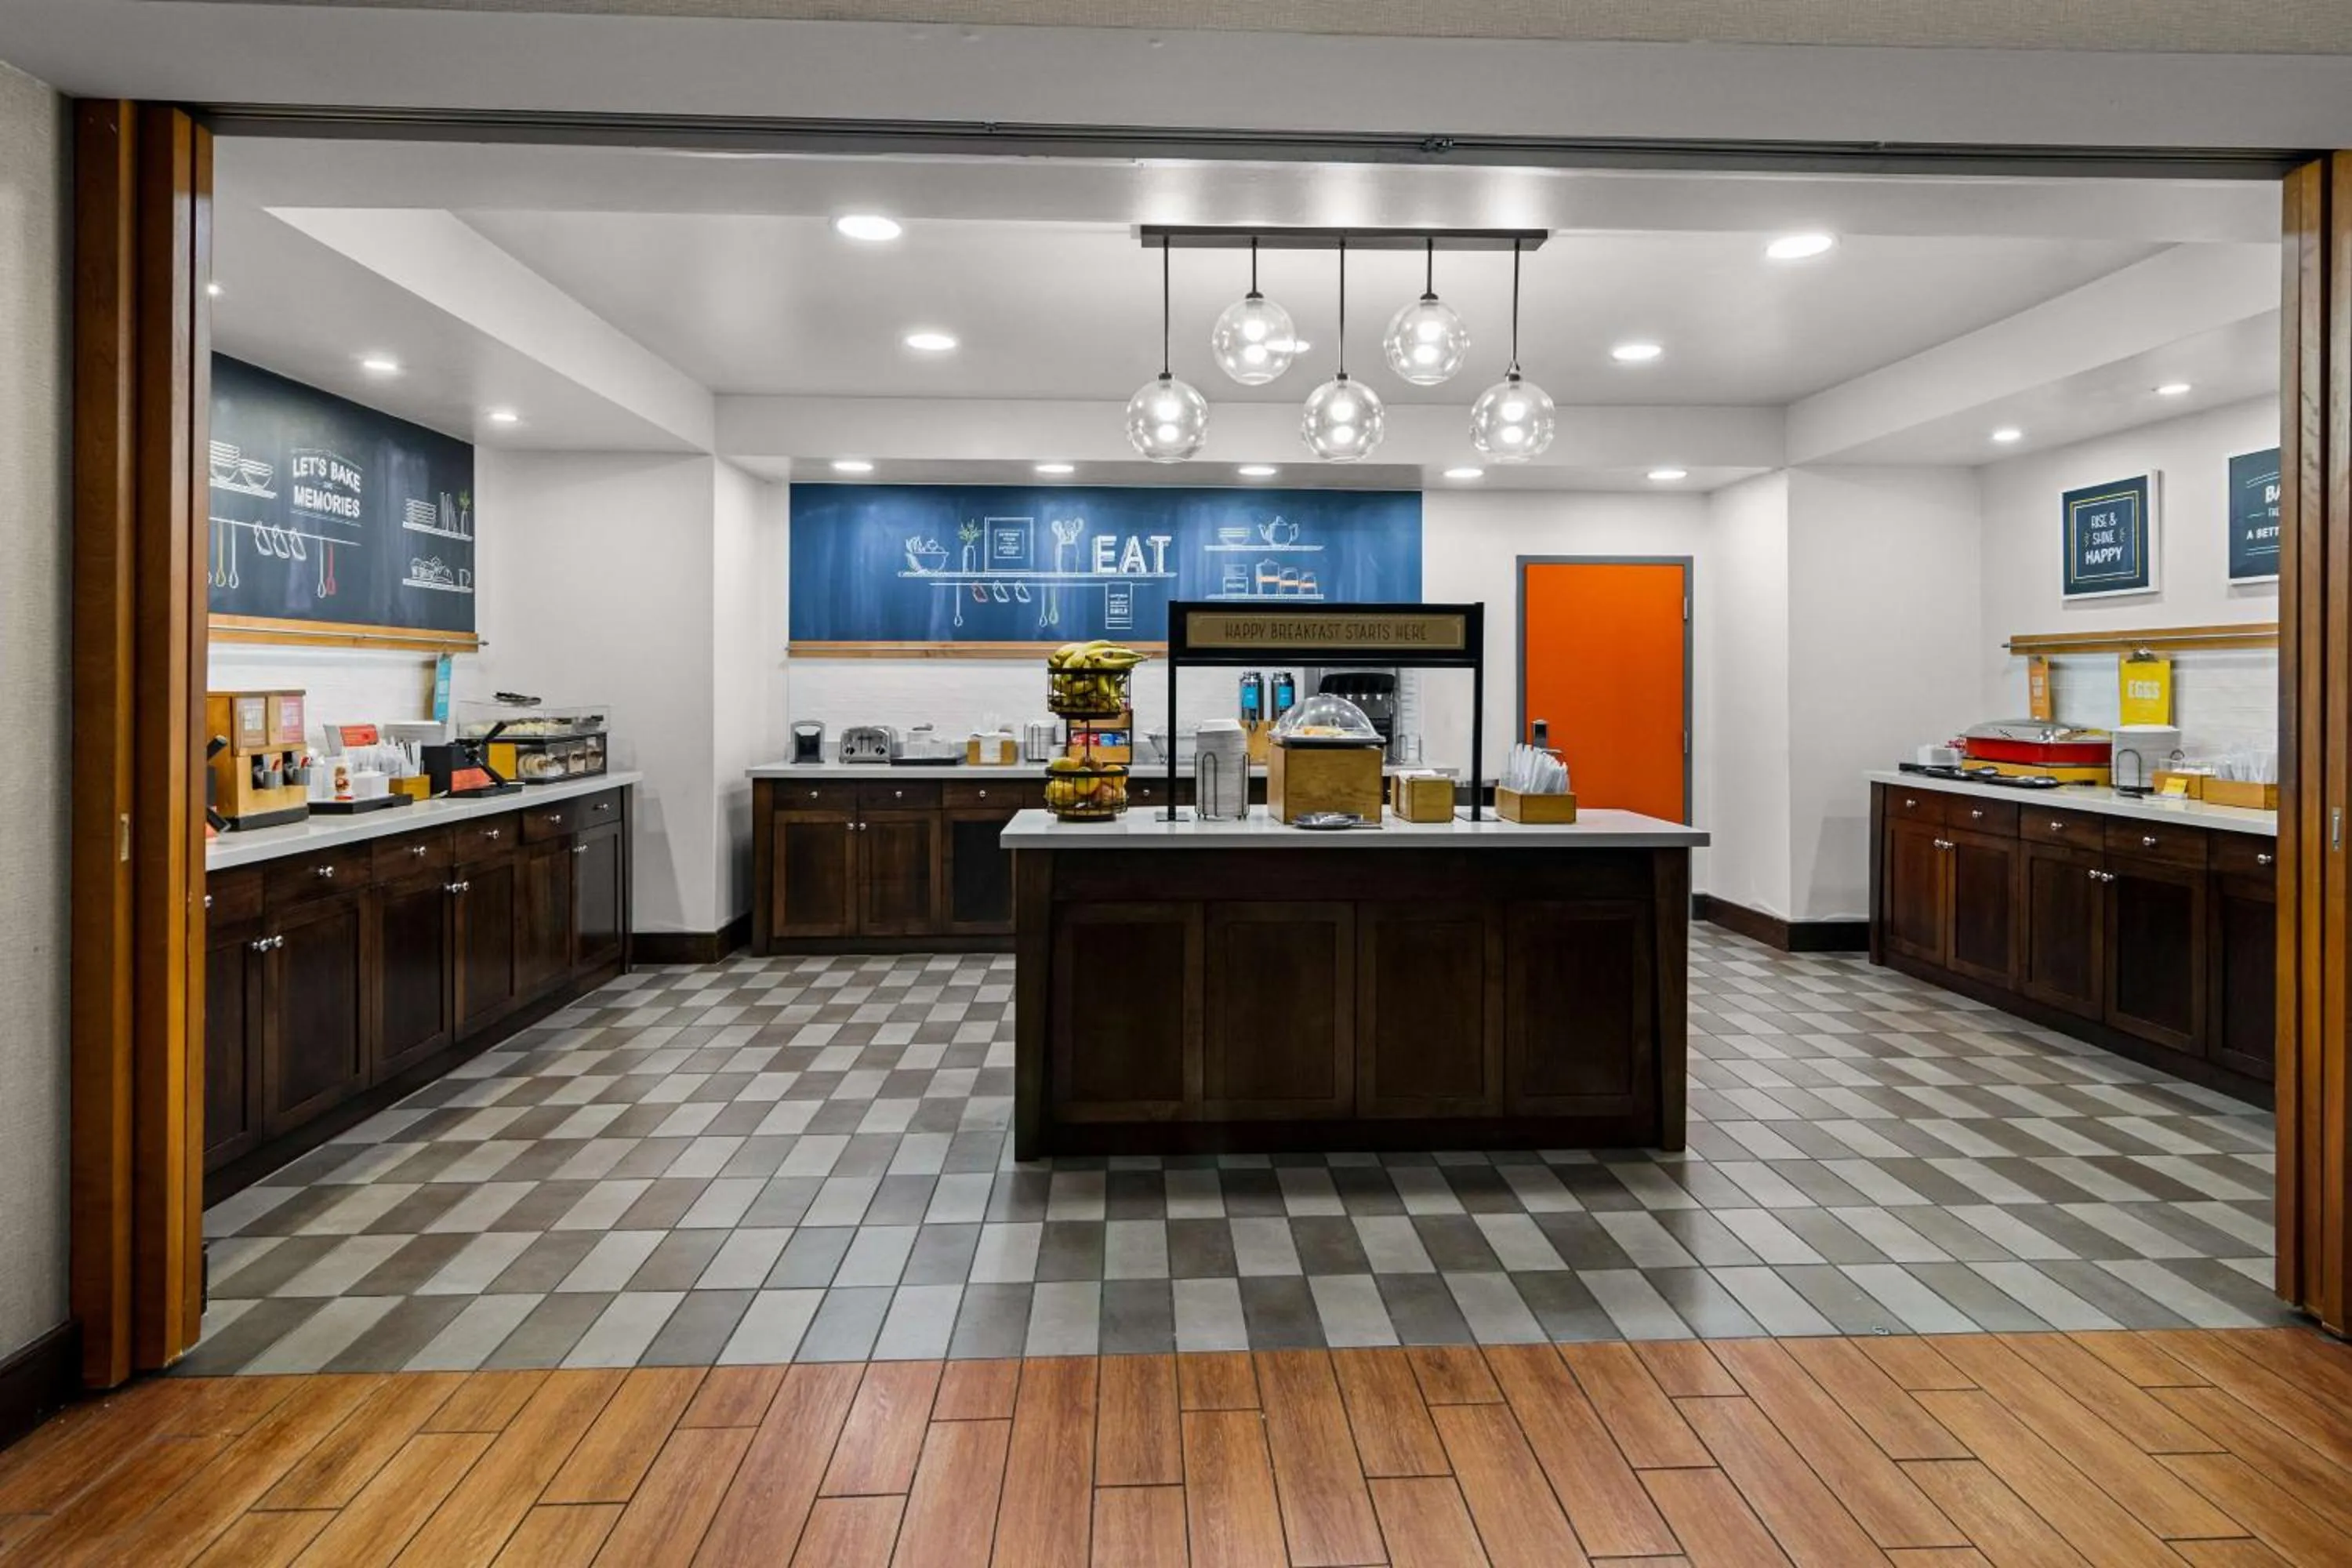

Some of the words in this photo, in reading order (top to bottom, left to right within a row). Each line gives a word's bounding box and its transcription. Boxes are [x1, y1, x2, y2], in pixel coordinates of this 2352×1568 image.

[292, 456, 327, 478] LET'S
[330, 460, 361, 494] BAKE
[294, 485, 360, 518] MEMORIES
[2092, 529, 2115, 546] SHINE
[2246, 529, 2254, 540] A
[1092, 535, 1172, 575] EAT
[2085, 546, 2123, 564] HAPPY
[1225, 622, 1265, 640] HAPPY
[1270, 622, 1341, 641] BREAKFAST
[1345, 622, 1392, 641] STARTS
[1396, 622, 1426, 641] HERE
